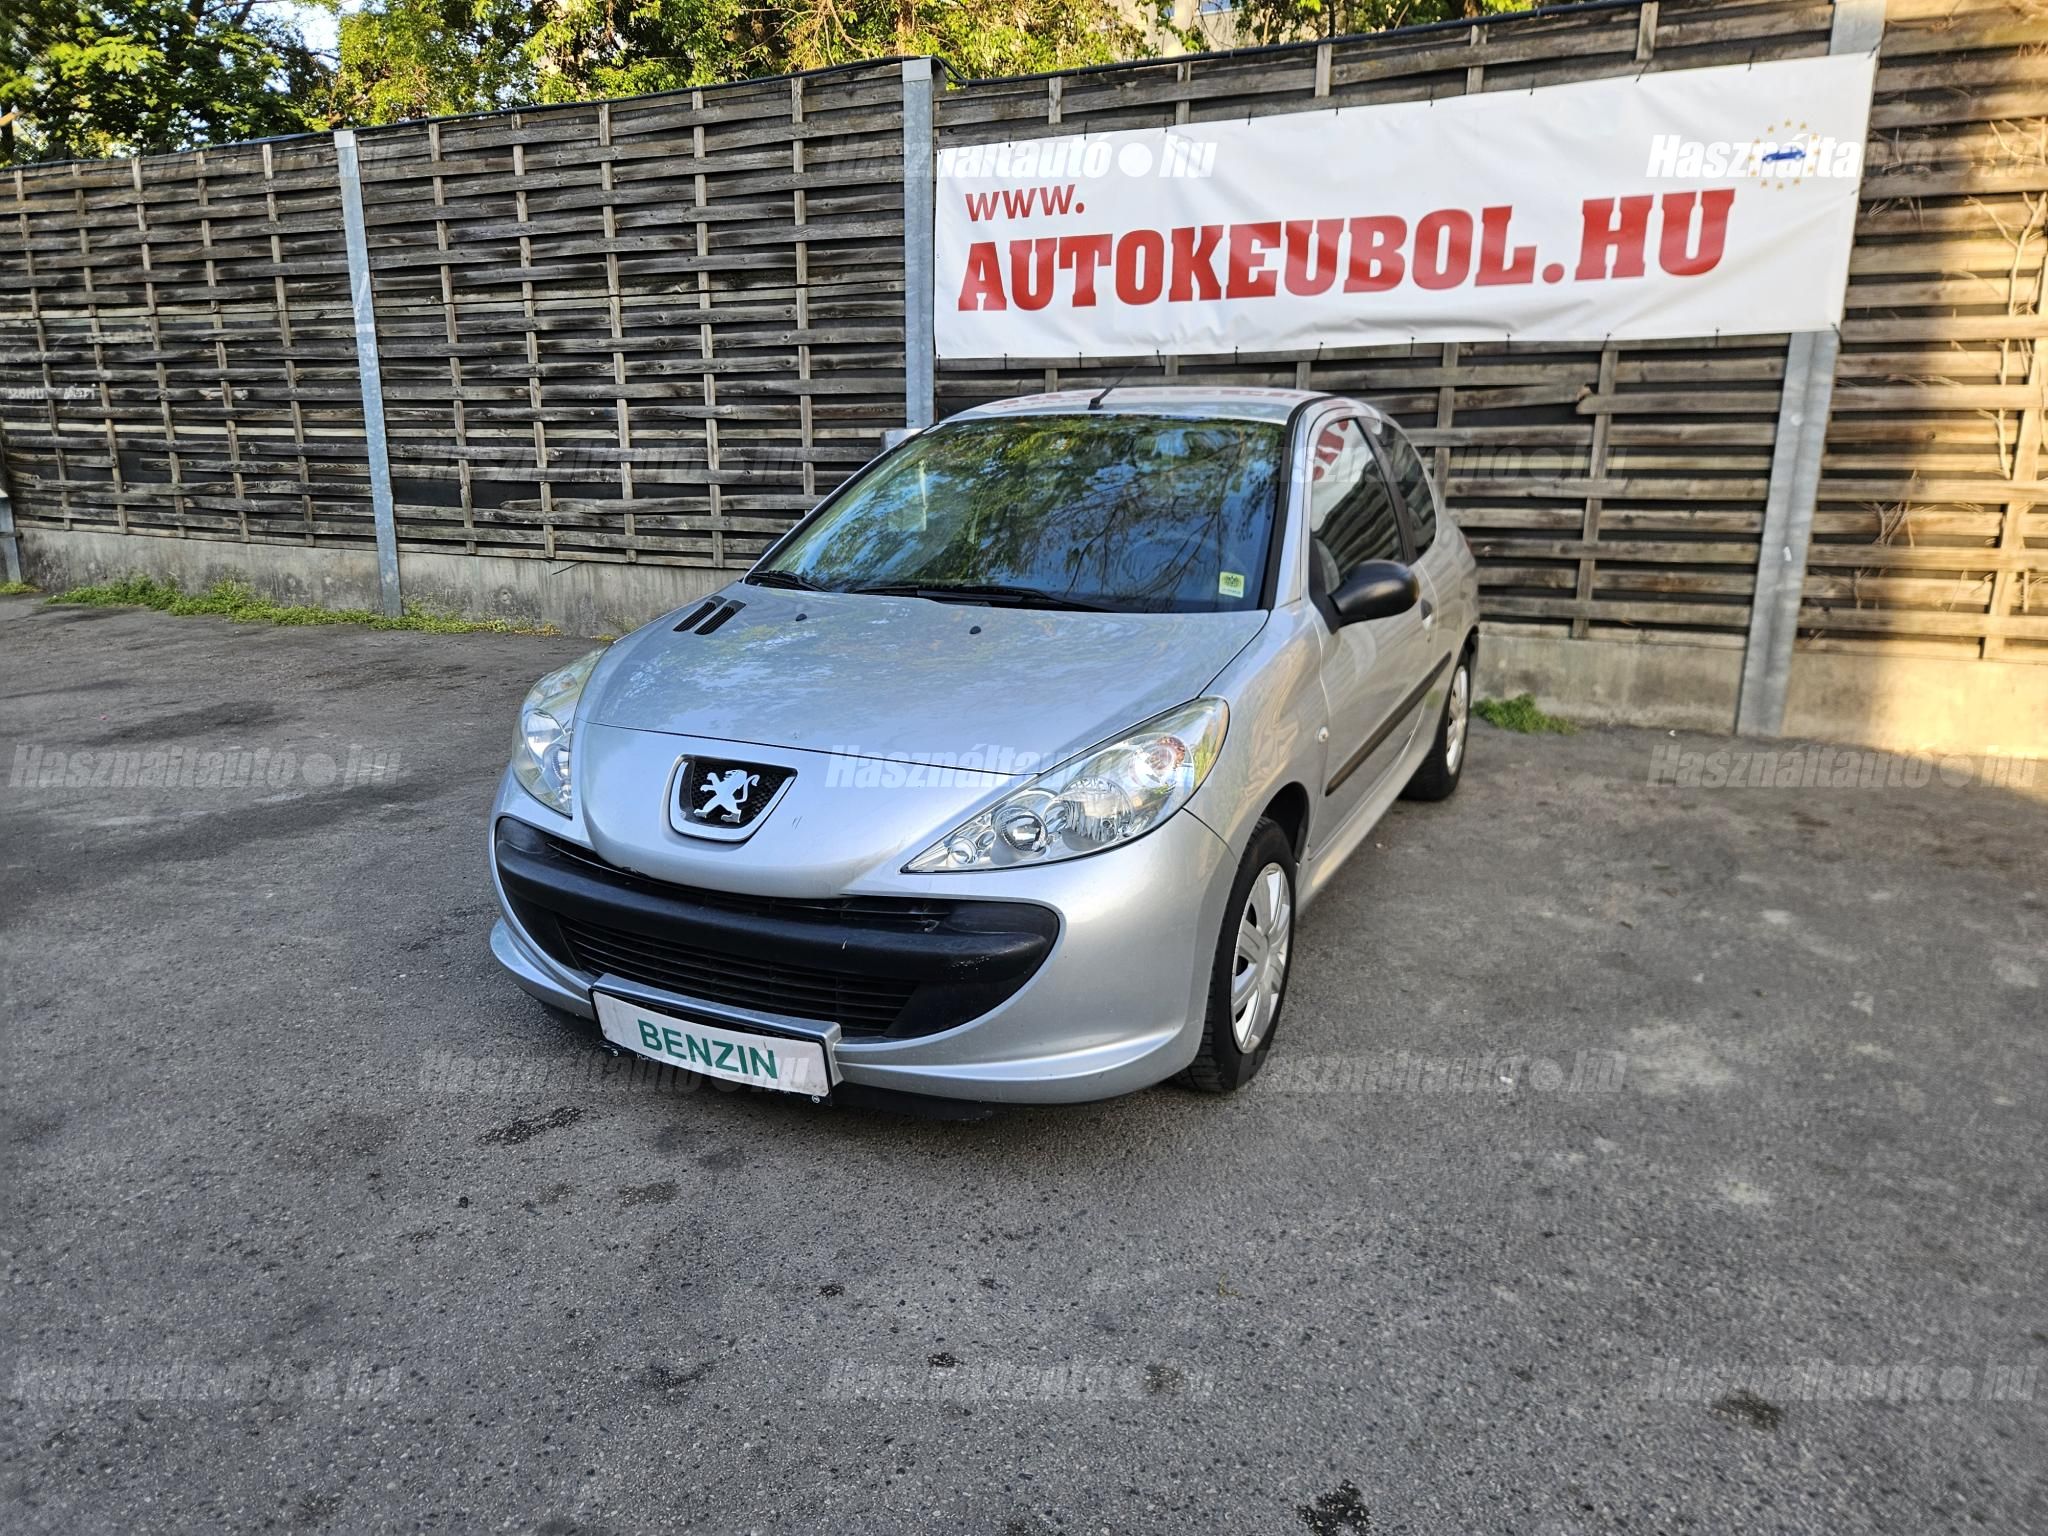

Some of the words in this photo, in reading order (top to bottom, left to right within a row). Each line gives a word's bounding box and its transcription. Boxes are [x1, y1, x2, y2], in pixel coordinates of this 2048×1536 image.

[965, 184, 1086, 221] www.
[958, 188, 1736, 311] AUTOKEUBOL.HU
[637, 1019, 778, 1080] BENZIN
